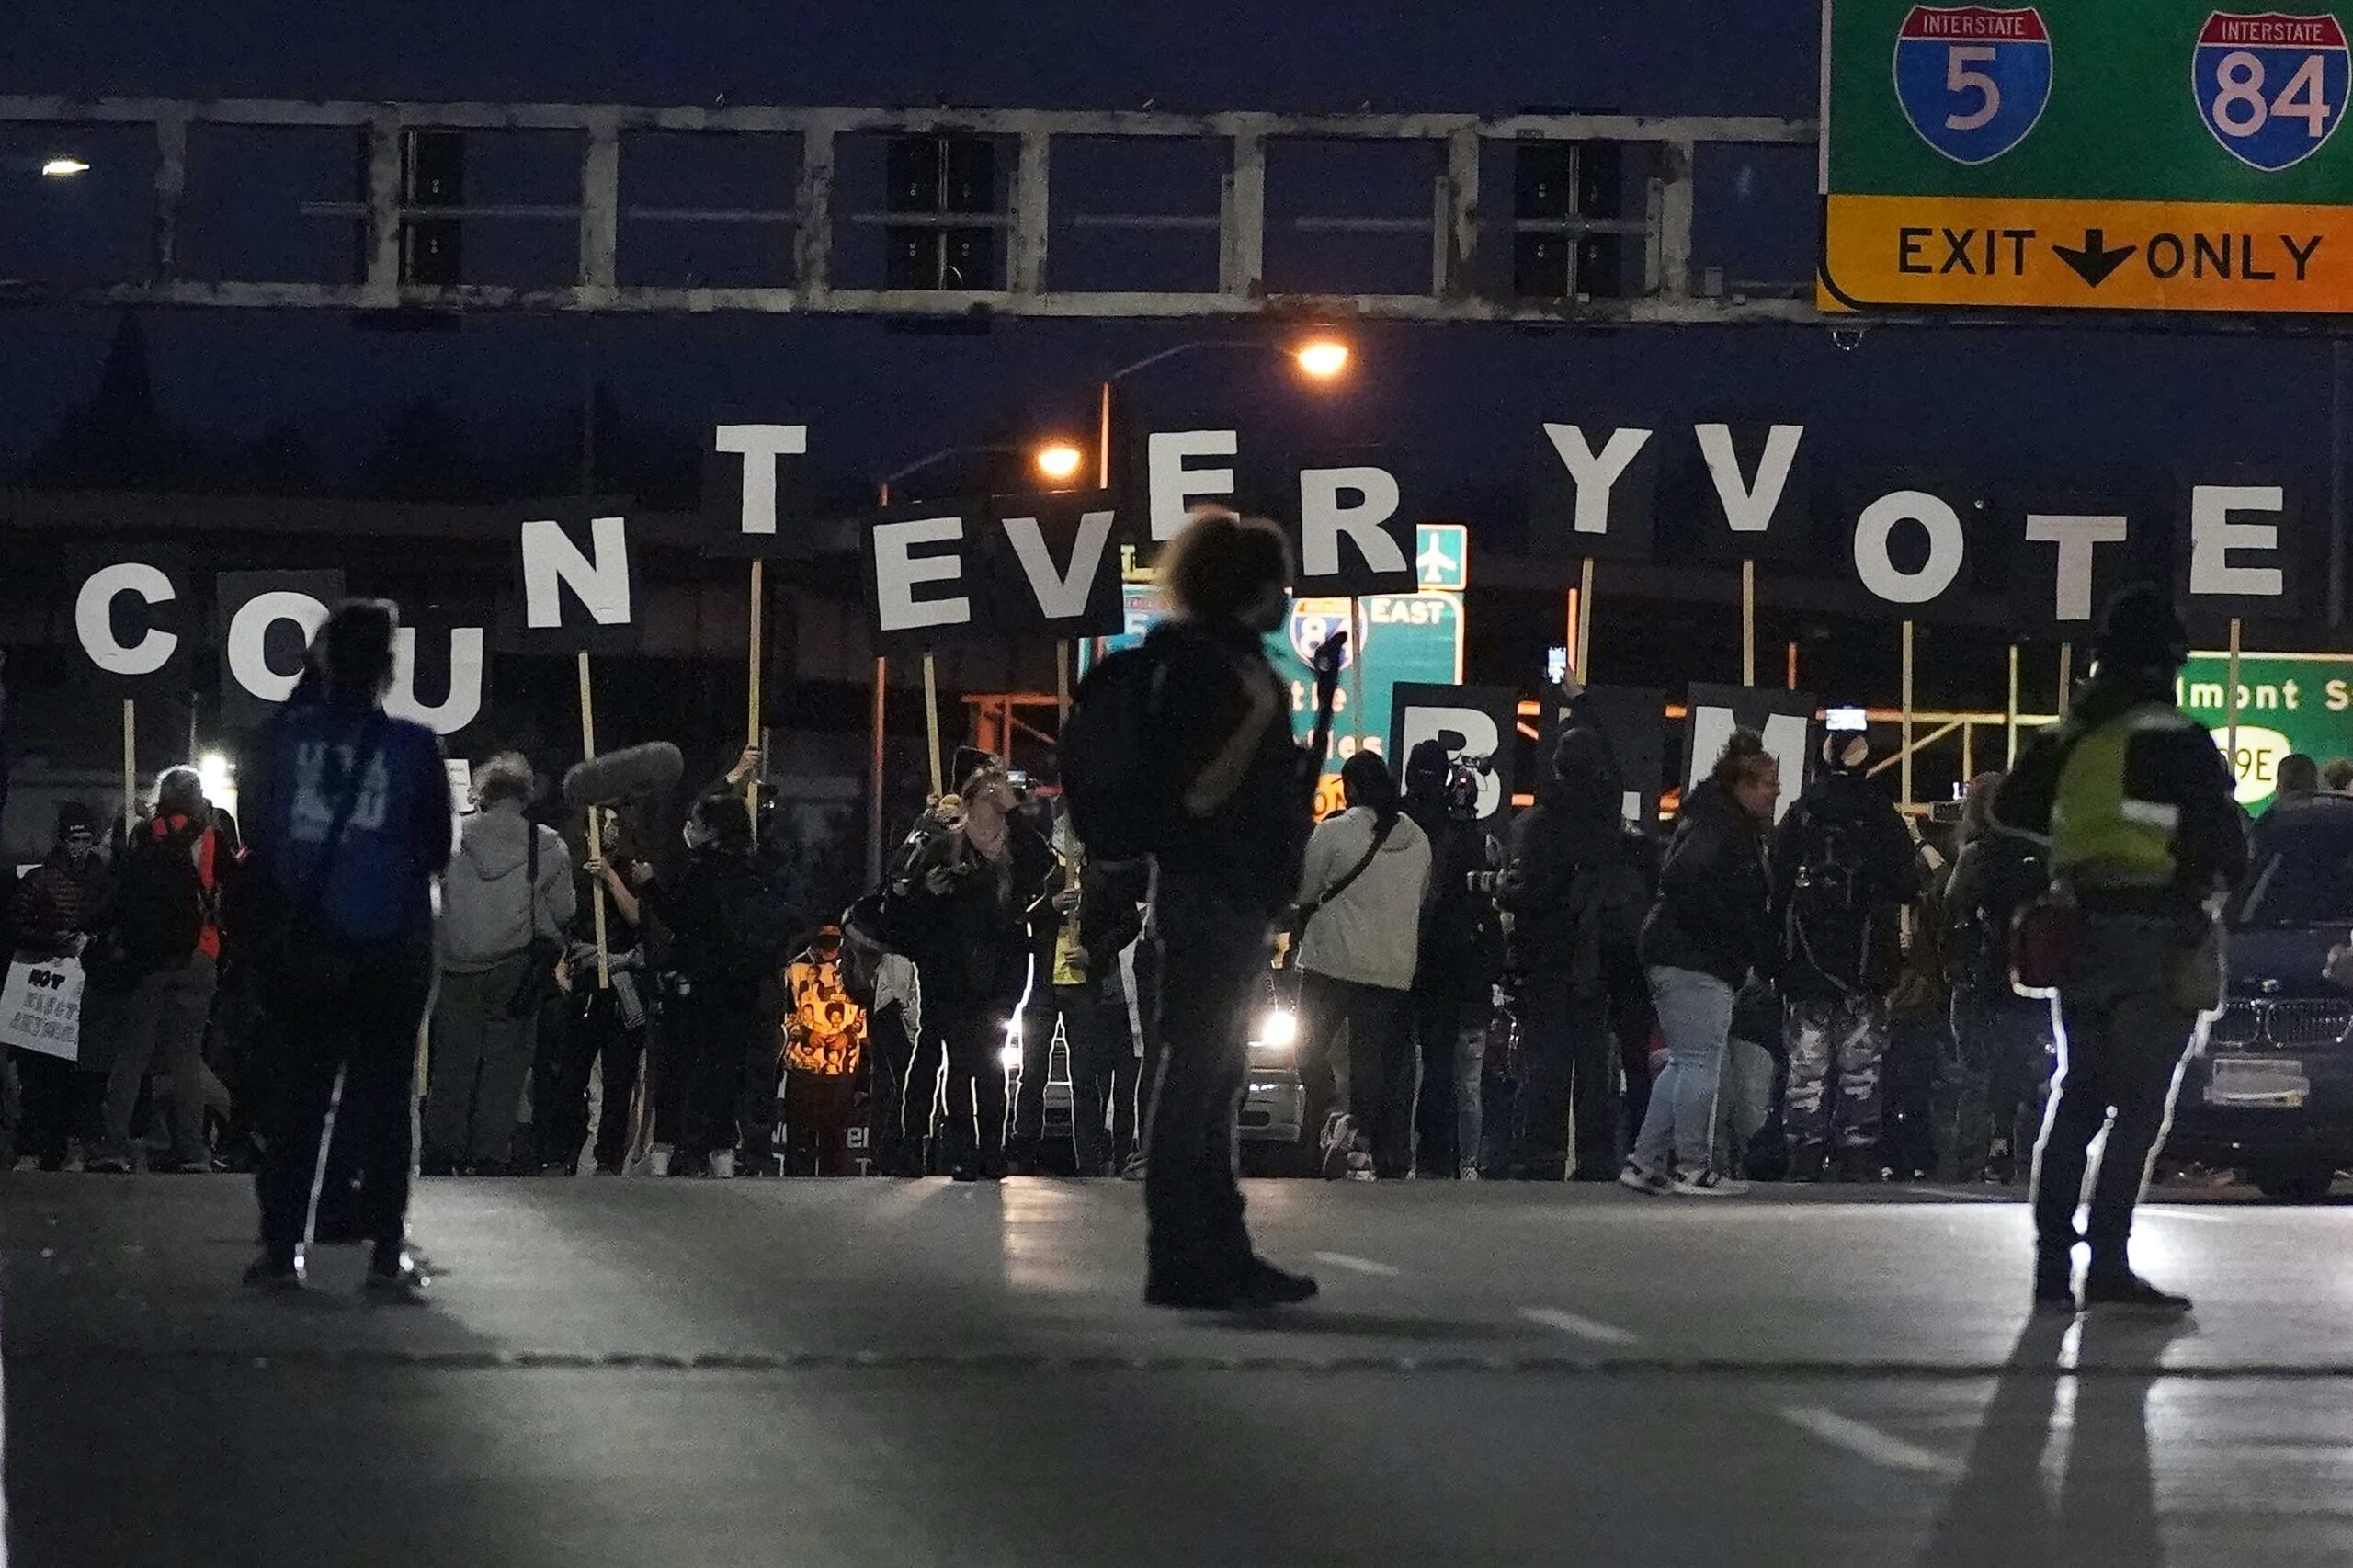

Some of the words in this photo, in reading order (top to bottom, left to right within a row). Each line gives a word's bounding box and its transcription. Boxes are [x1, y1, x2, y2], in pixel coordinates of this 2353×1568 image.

[1924, 15, 2025, 36] INTERSTATE
[2222, 21, 2324, 41] INTERSTATE
[1945, 46, 2000, 130] 5
[2212, 51, 2330, 137] 84
[1900, 228, 2036, 275] EXIT
[2147, 233, 2324, 281] ONLY
[1370, 598, 1446, 624] EAST
[2176, 676, 2299, 711] lmont
[2325, 679, 2353, 711] S
